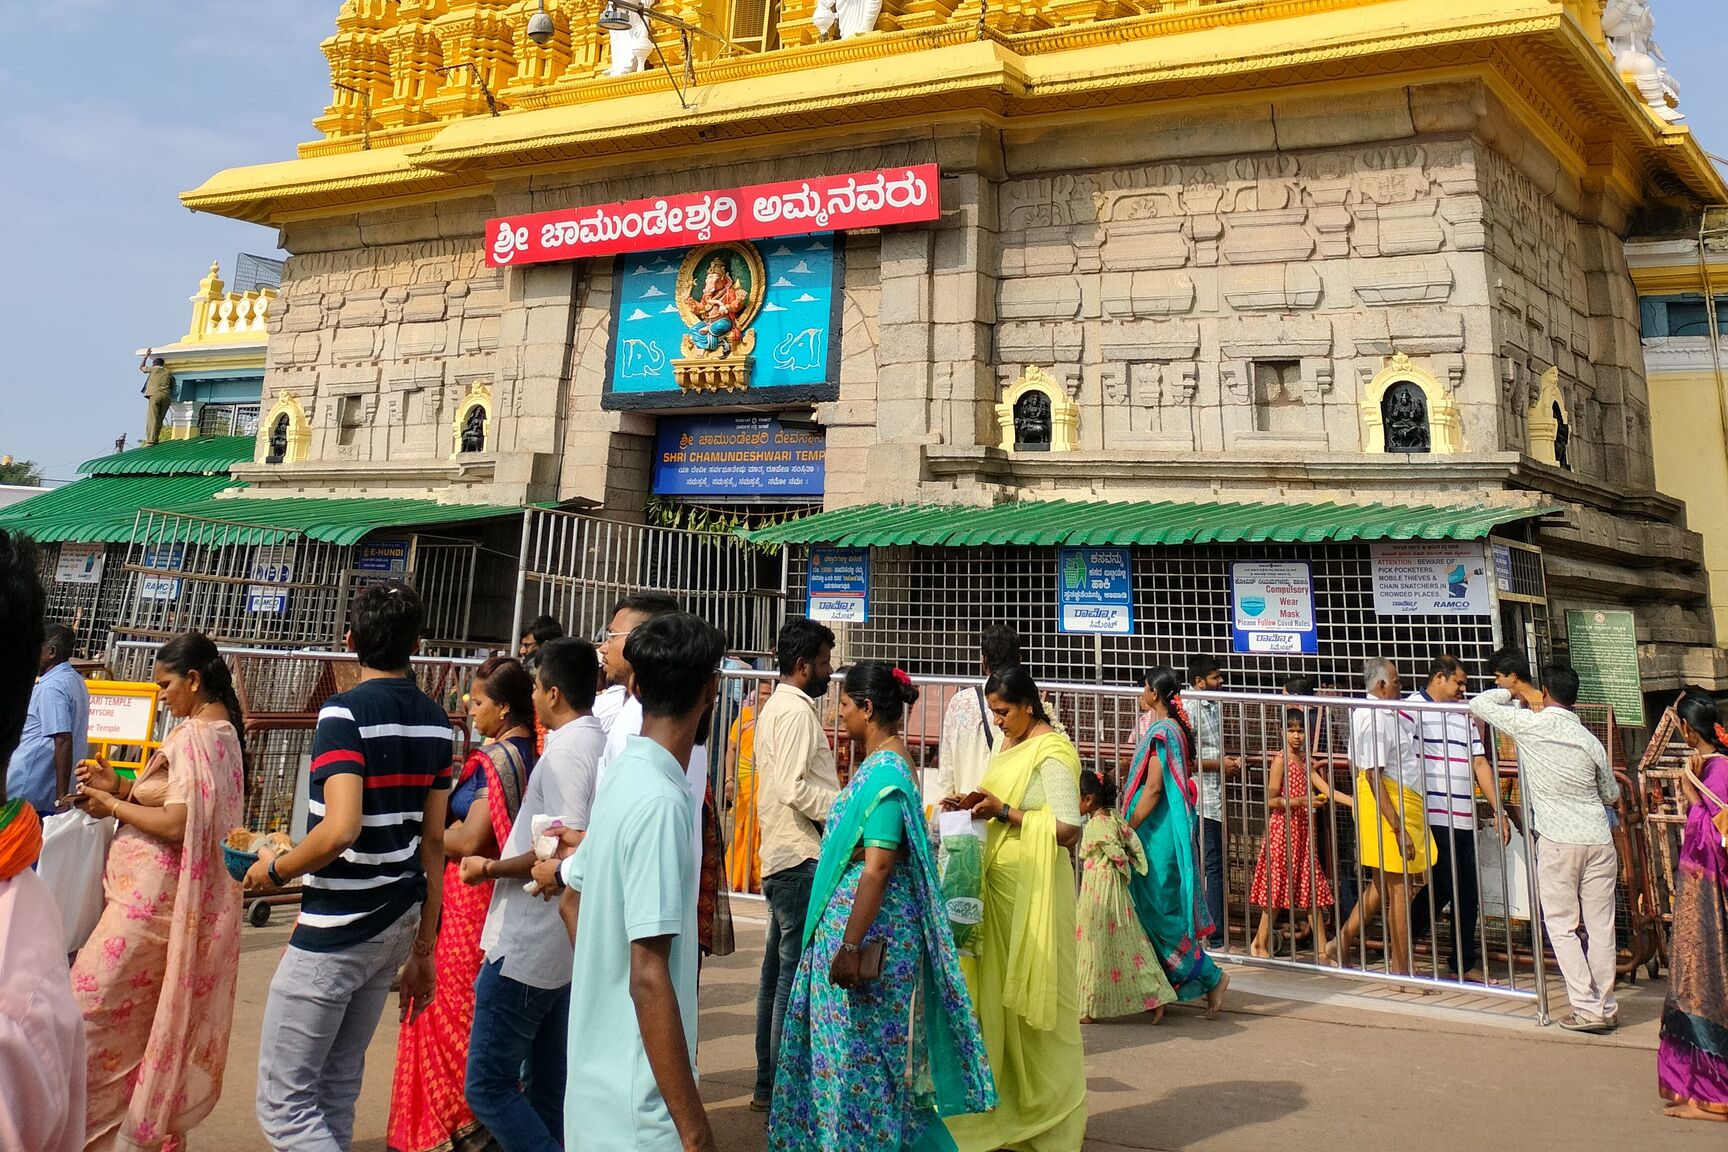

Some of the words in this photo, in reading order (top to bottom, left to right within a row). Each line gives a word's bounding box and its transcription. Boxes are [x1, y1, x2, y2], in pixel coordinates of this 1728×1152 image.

[493, 222, 529, 264] ಶ್ರೀ
[541, 195, 738, 241] ಚಾಮುಂಡೇಶ್ವರಿ
[752, 170, 927, 227] ಅಮ್ಮನವರು
[679, 432, 694, 449] ಶ್ರೀ
[663, 452, 687, 463] SHRI
[689, 450, 792, 463] CHAMUNDESHWARI
[795, 450, 826, 461] TEMP
[370, 548, 404, 557] E-HUNDI
[1265, 585, 1309, 595] Compulsory
[1280, 597, 1299, 606] Wear
[1280, 610, 1300, 618] Mask
[1277, 619, 1294, 627] Covid
[104, 697, 132, 707] TEMPLE
[89, 708, 115, 717] MYSORE
[96, 723, 120, 732] Temple
